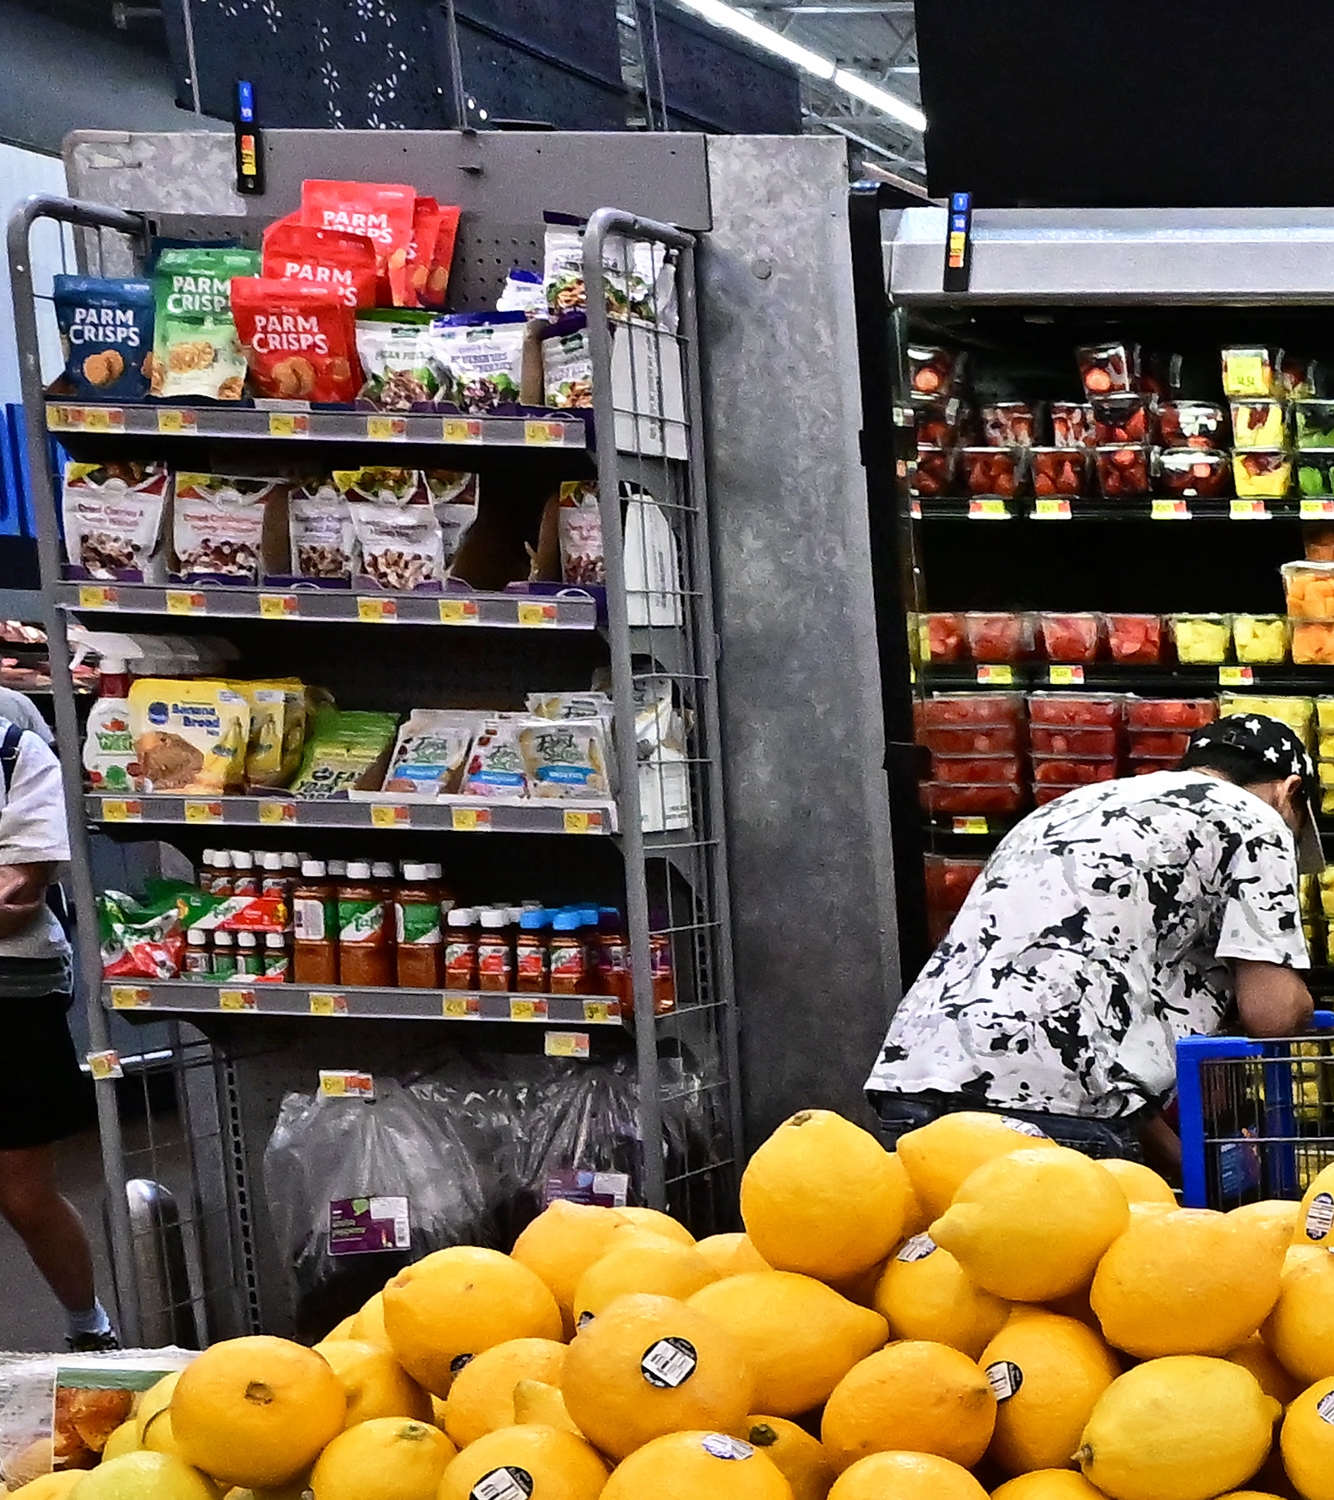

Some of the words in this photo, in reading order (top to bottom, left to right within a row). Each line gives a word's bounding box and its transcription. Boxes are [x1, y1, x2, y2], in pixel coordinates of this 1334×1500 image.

[322, 210, 388, 228] PARM
[285, 262, 352, 285] PARM
[172, 275, 230, 294] PARM
[166, 293, 230, 313] CRISP
[74, 308, 134, 325] PARM
[254, 314, 319, 333] PARM
[69, 323, 141, 348] CRISPS
[252, 331, 328, 355] CRISPS
[183, 715, 220, 728] Bread
